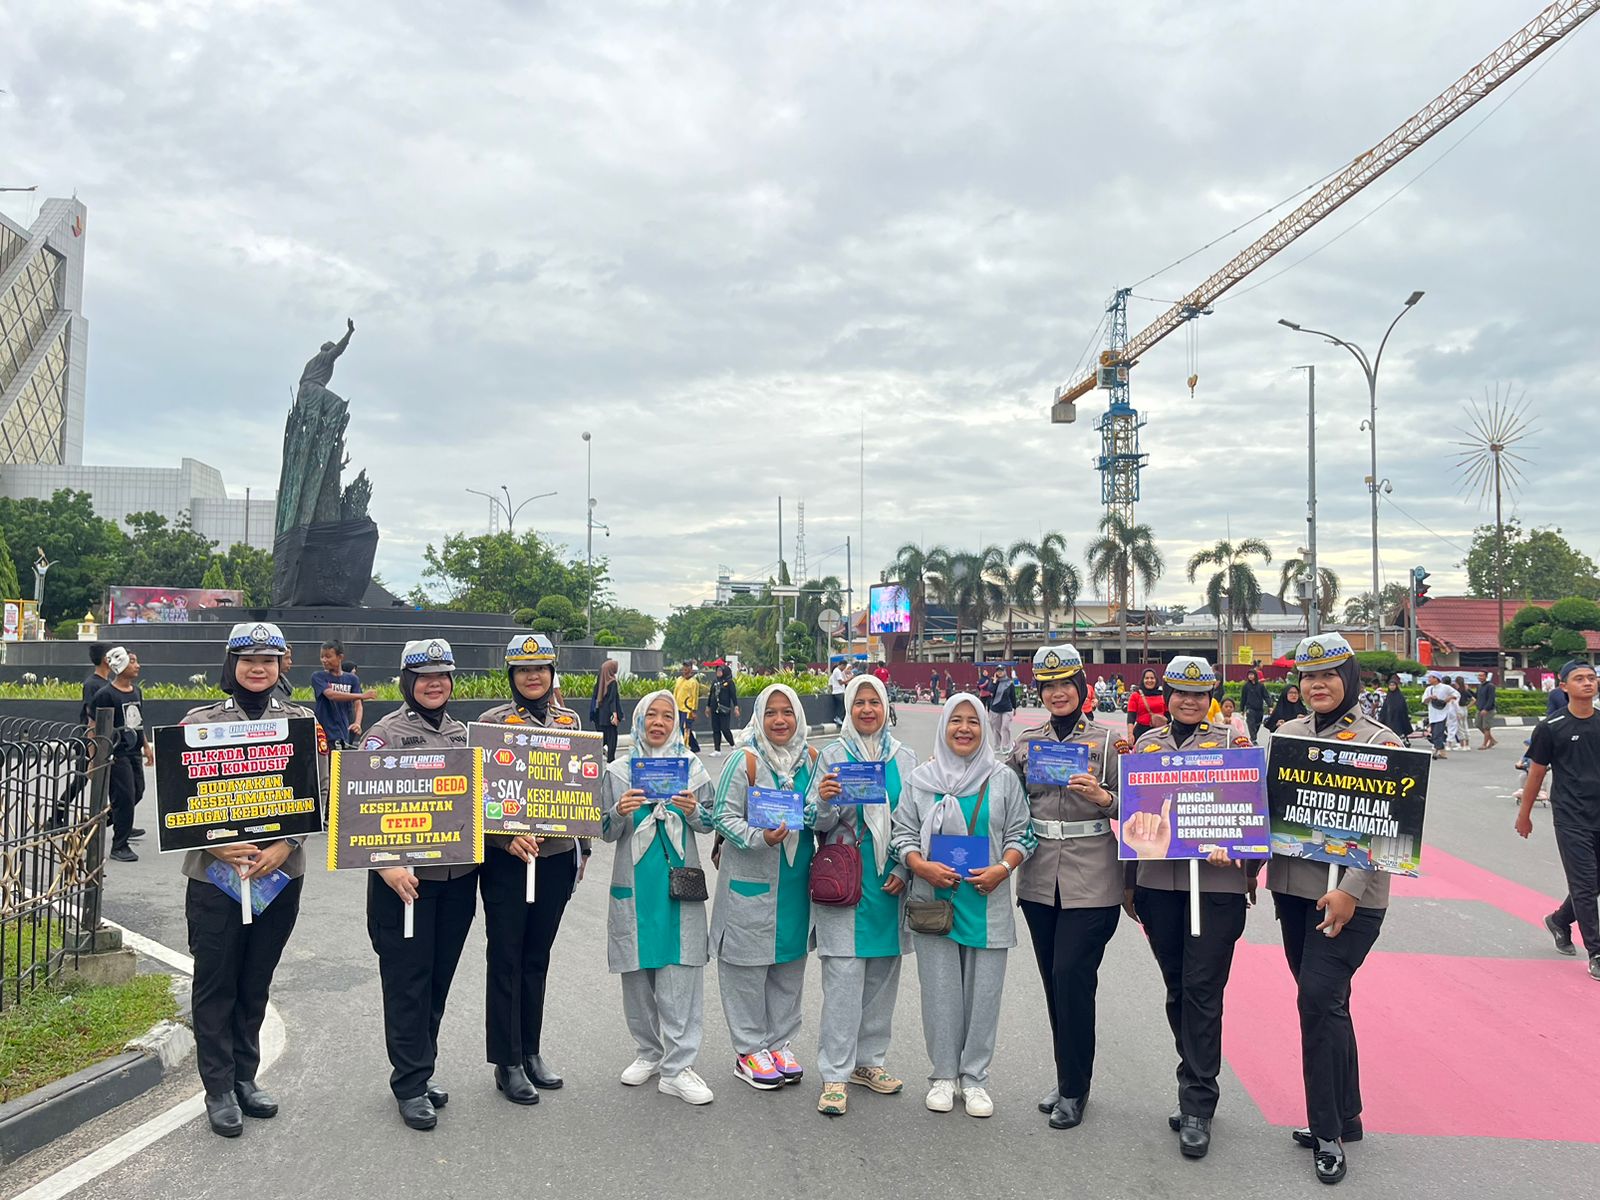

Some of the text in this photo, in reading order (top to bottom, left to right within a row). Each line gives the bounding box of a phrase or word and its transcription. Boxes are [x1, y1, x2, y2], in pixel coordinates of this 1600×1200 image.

[183, 744, 293, 764] PILKADA DAMAI
[482, 749, 527, 772] AY NO to
[528, 751, 561, 766] MONEY
[1338, 750, 1388, 763] DITLANTAS
[189, 758, 288, 778] DAN KONDUSIF
[528, 766, 563, 781] POLITIK
[1129, 768, 1259, 785] BERIKAN HAK PILIHMU
[199, 775, 283, 795] BUDAYAKAN
[347, 778, 465, 795] PILIHAN BOLEH BEDA
[497, 780, 523, 799] SAY
[1278, 767, 1415, 797] MAU KAMPANYE ?
[189, 788, 293, 810] KESELAMATAN
[527, 788, 592, 806] KESELAMATAN
[1177, 792, 1214, 803] JANGAN
[1296, 789, 1392, 821] TERTIB DI JALAN,
[166, 799, 314, 827] SEBAGAI KEBUTUHAN
[360, 801, 453, 814] KESELAMATAN
[503, 801, 517, 813] YES
[526, 804, 601, 821] BERLALU LINTAS
[1177, 803, 1253, 815] MENGGUNAKAN
[386, 817, 427, 829] TETAP
[1177, 815, 1264, 827] HANDPHONE SAAT
[1283, 805, 1399, 838] JAGA KESELAMATAN
[350, 831, 461, 847] PRORITAS UTAMA
[1177, 828, 1243, 839] BERKENDARA
